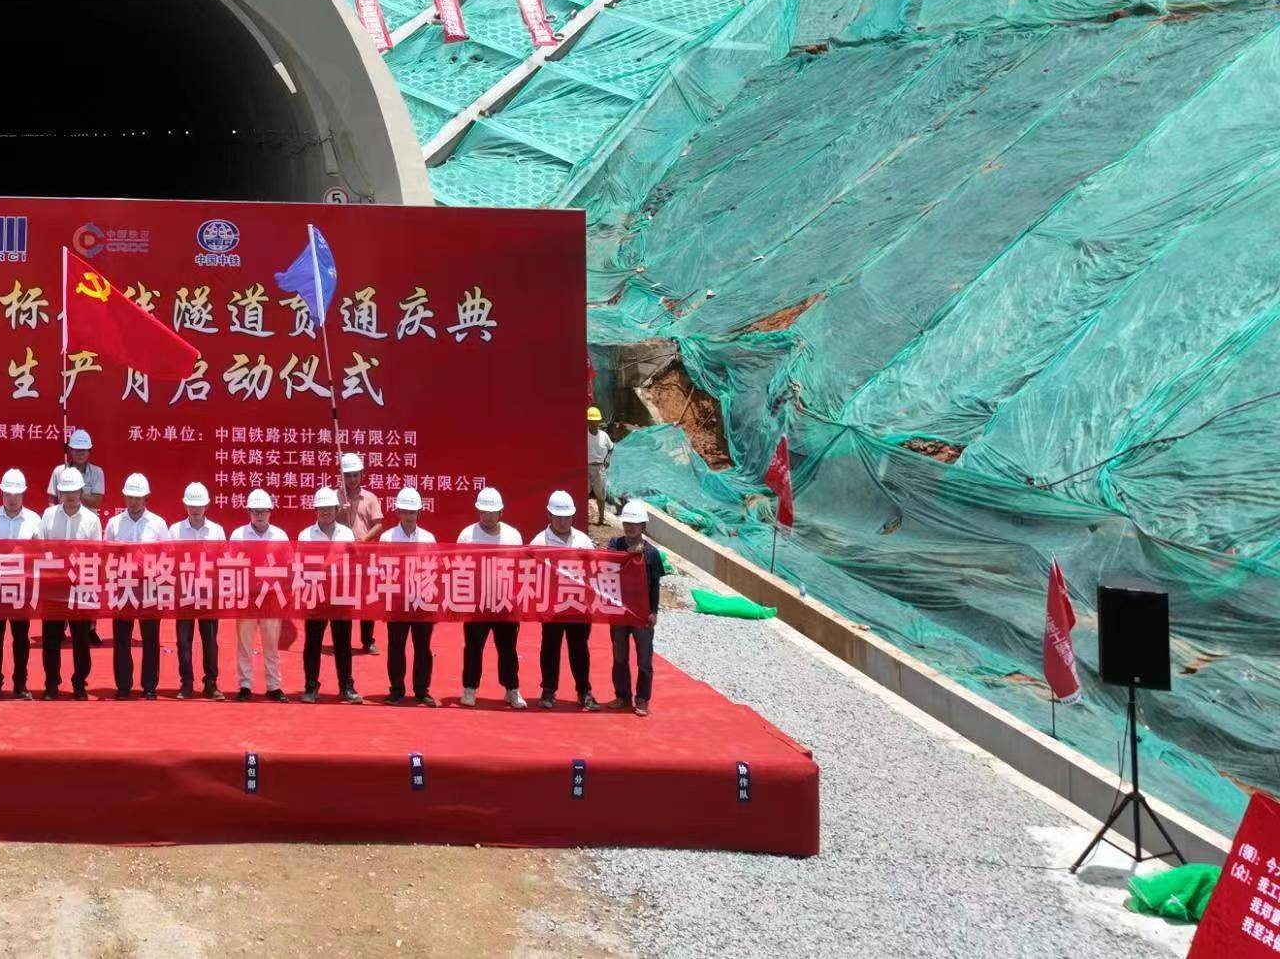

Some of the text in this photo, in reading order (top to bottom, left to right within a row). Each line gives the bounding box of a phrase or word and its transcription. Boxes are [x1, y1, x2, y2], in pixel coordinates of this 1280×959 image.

[195, 253, 240, 266] 中国中铁
[215, 470, 487, 492] 中铁咨询集团北程检测有限公司
